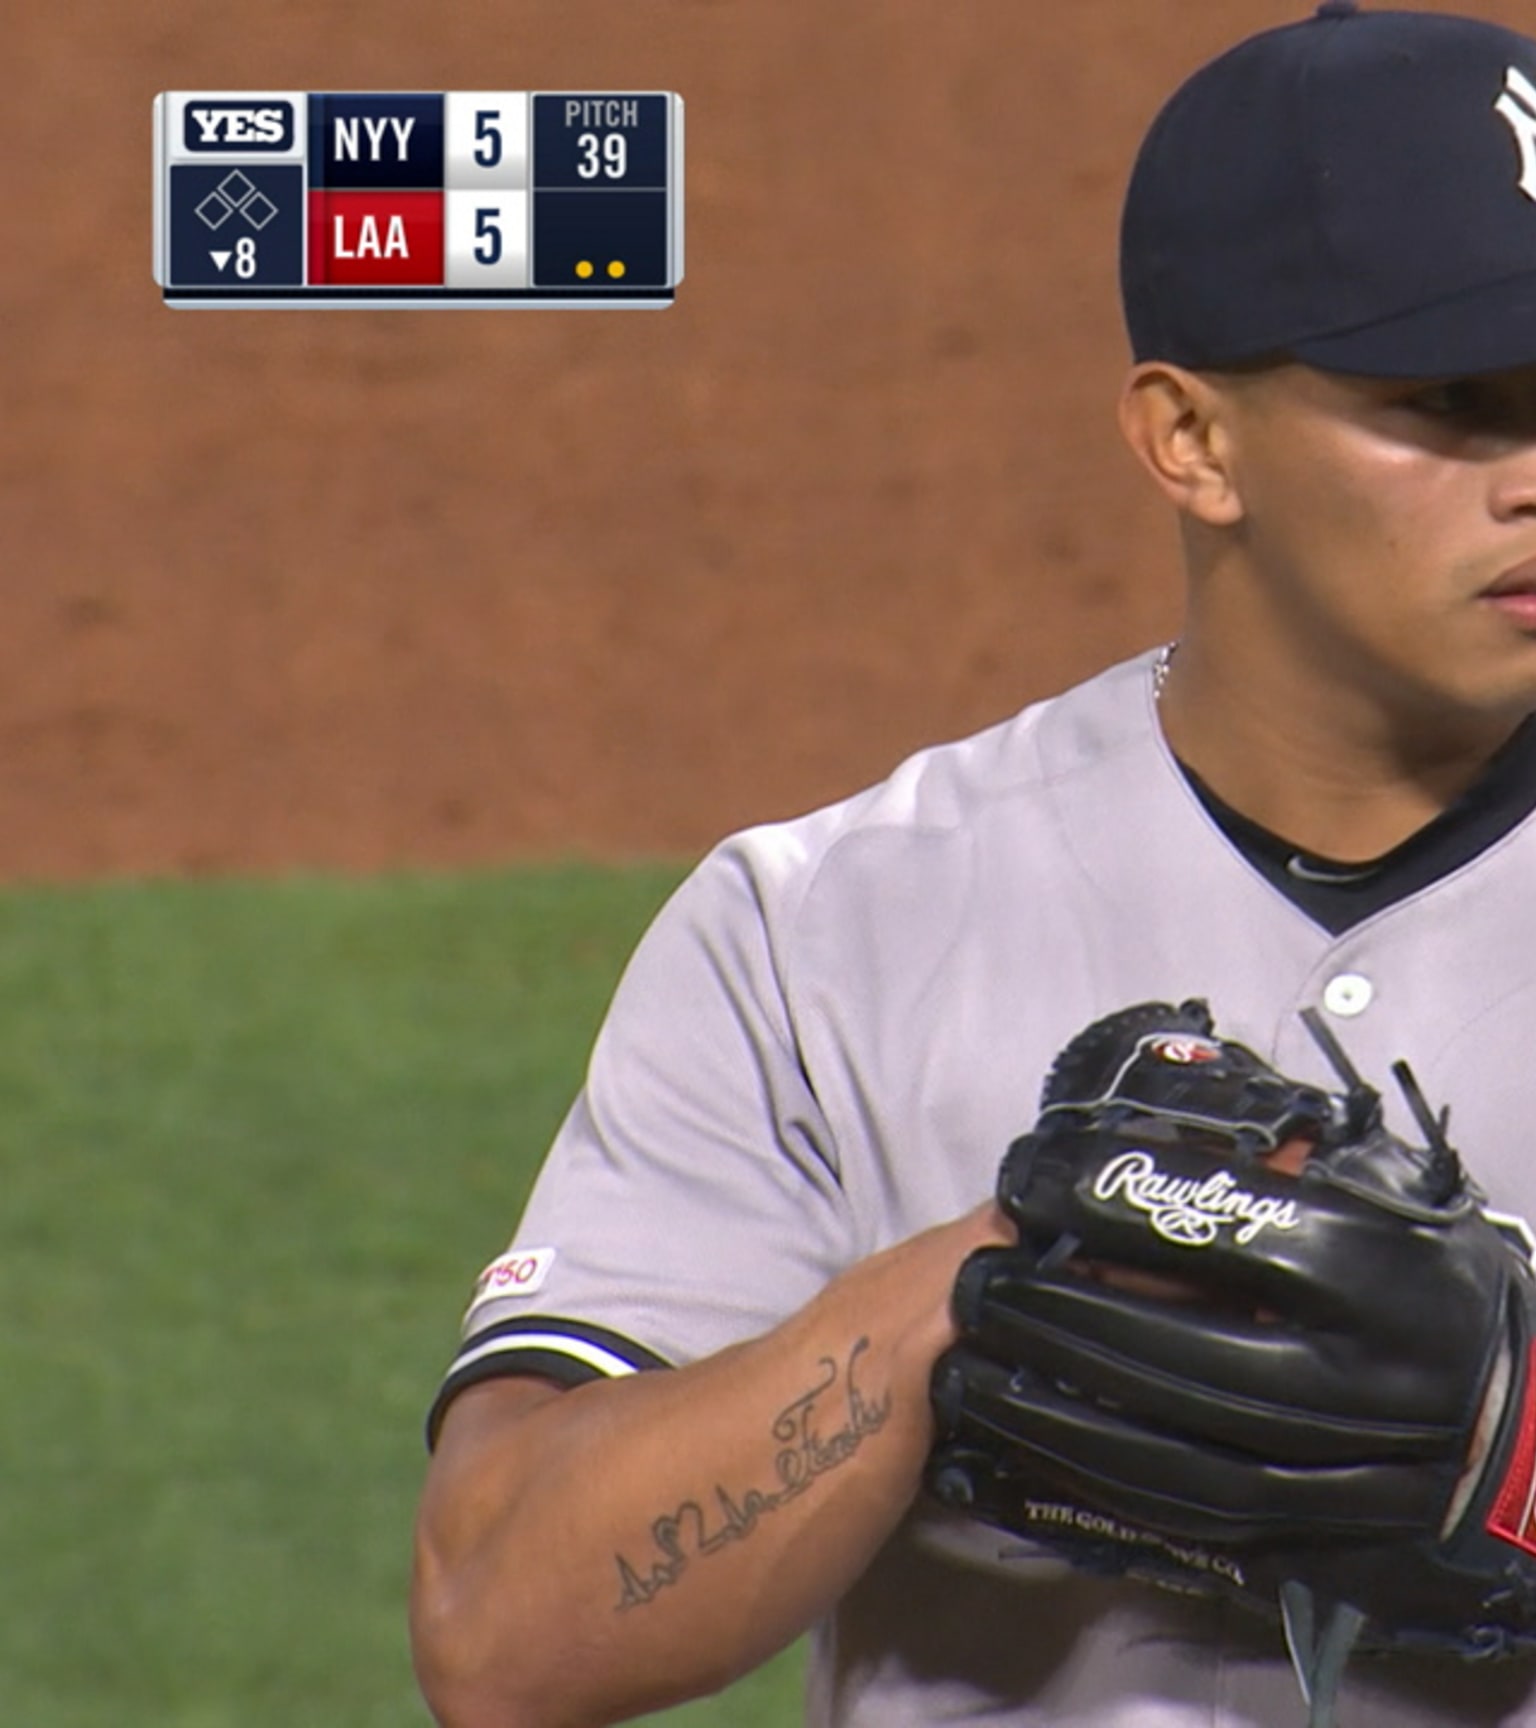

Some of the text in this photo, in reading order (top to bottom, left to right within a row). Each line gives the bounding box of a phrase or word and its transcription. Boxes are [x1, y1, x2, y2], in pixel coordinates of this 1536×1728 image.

[1093, 1150, 1300, 1246] Rawlings
[1023, 1499, 1074, 1525] THE
[1074, 1510, 1137, 1542] GOLD
